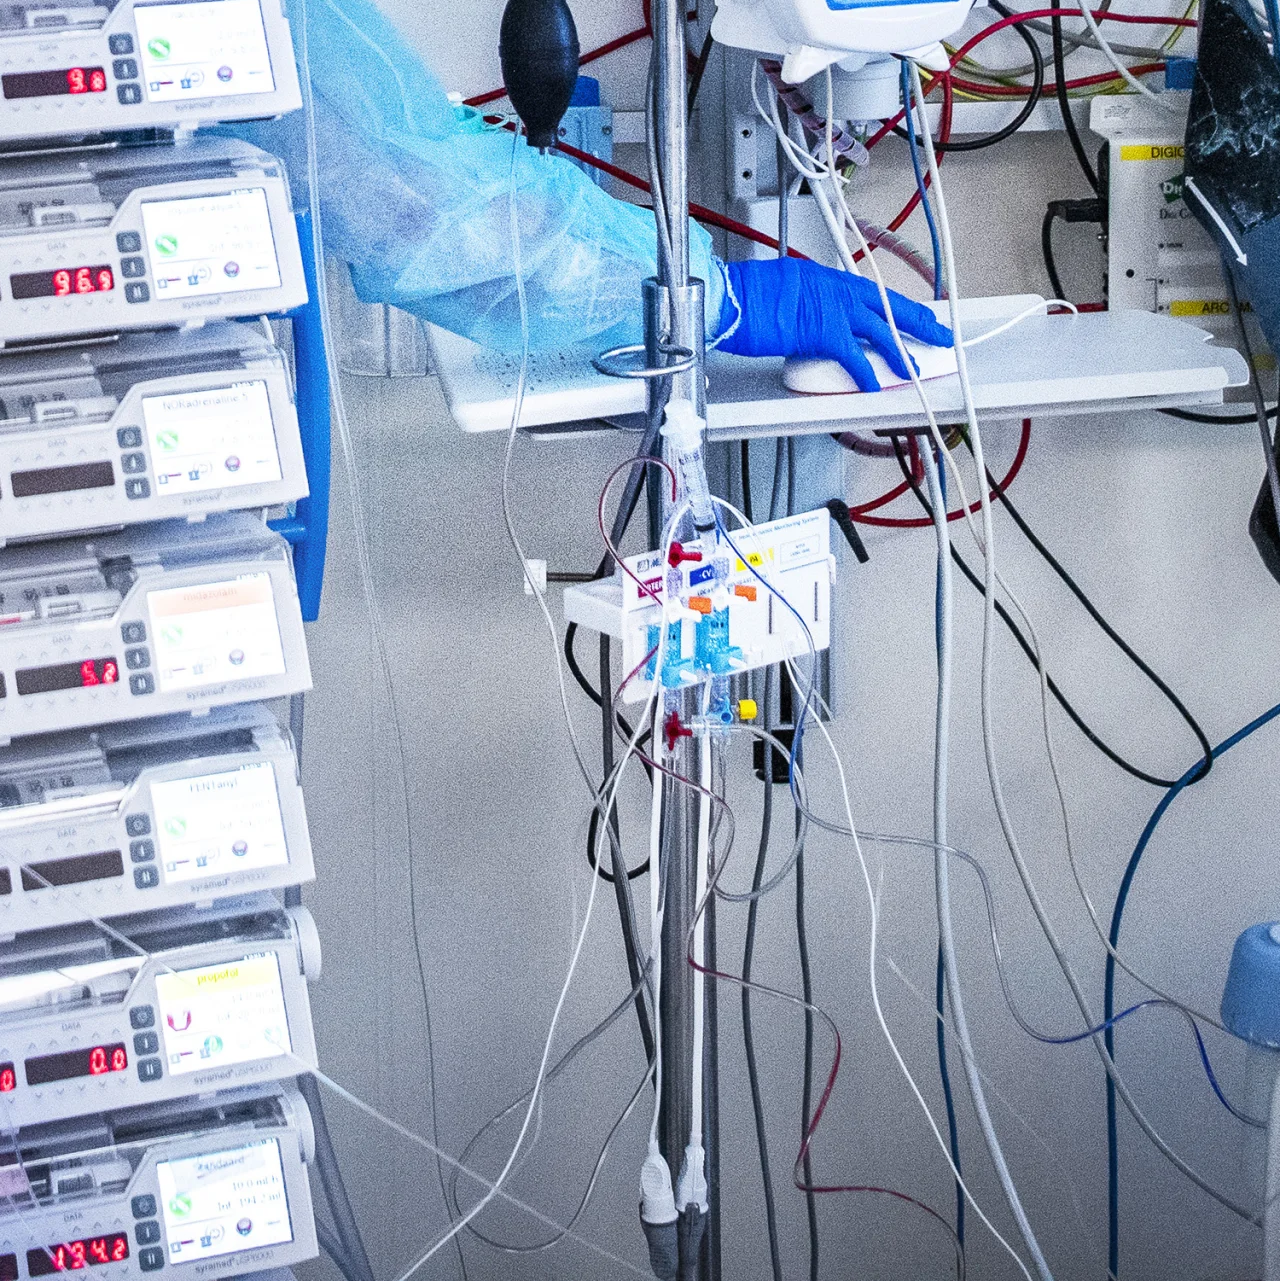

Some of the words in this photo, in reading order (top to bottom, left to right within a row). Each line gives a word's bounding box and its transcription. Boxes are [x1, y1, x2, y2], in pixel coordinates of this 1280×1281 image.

[162, 395, 239, 411] NORadrenaline
[183, 588, 238, 602] midazolam
[189, 777, 238, 793] FENTanyl
[196, 967, 239, 986] propofol
[89, 1047, 127, 1076] 0.0
[0, 1069, 15, 1092] 0
